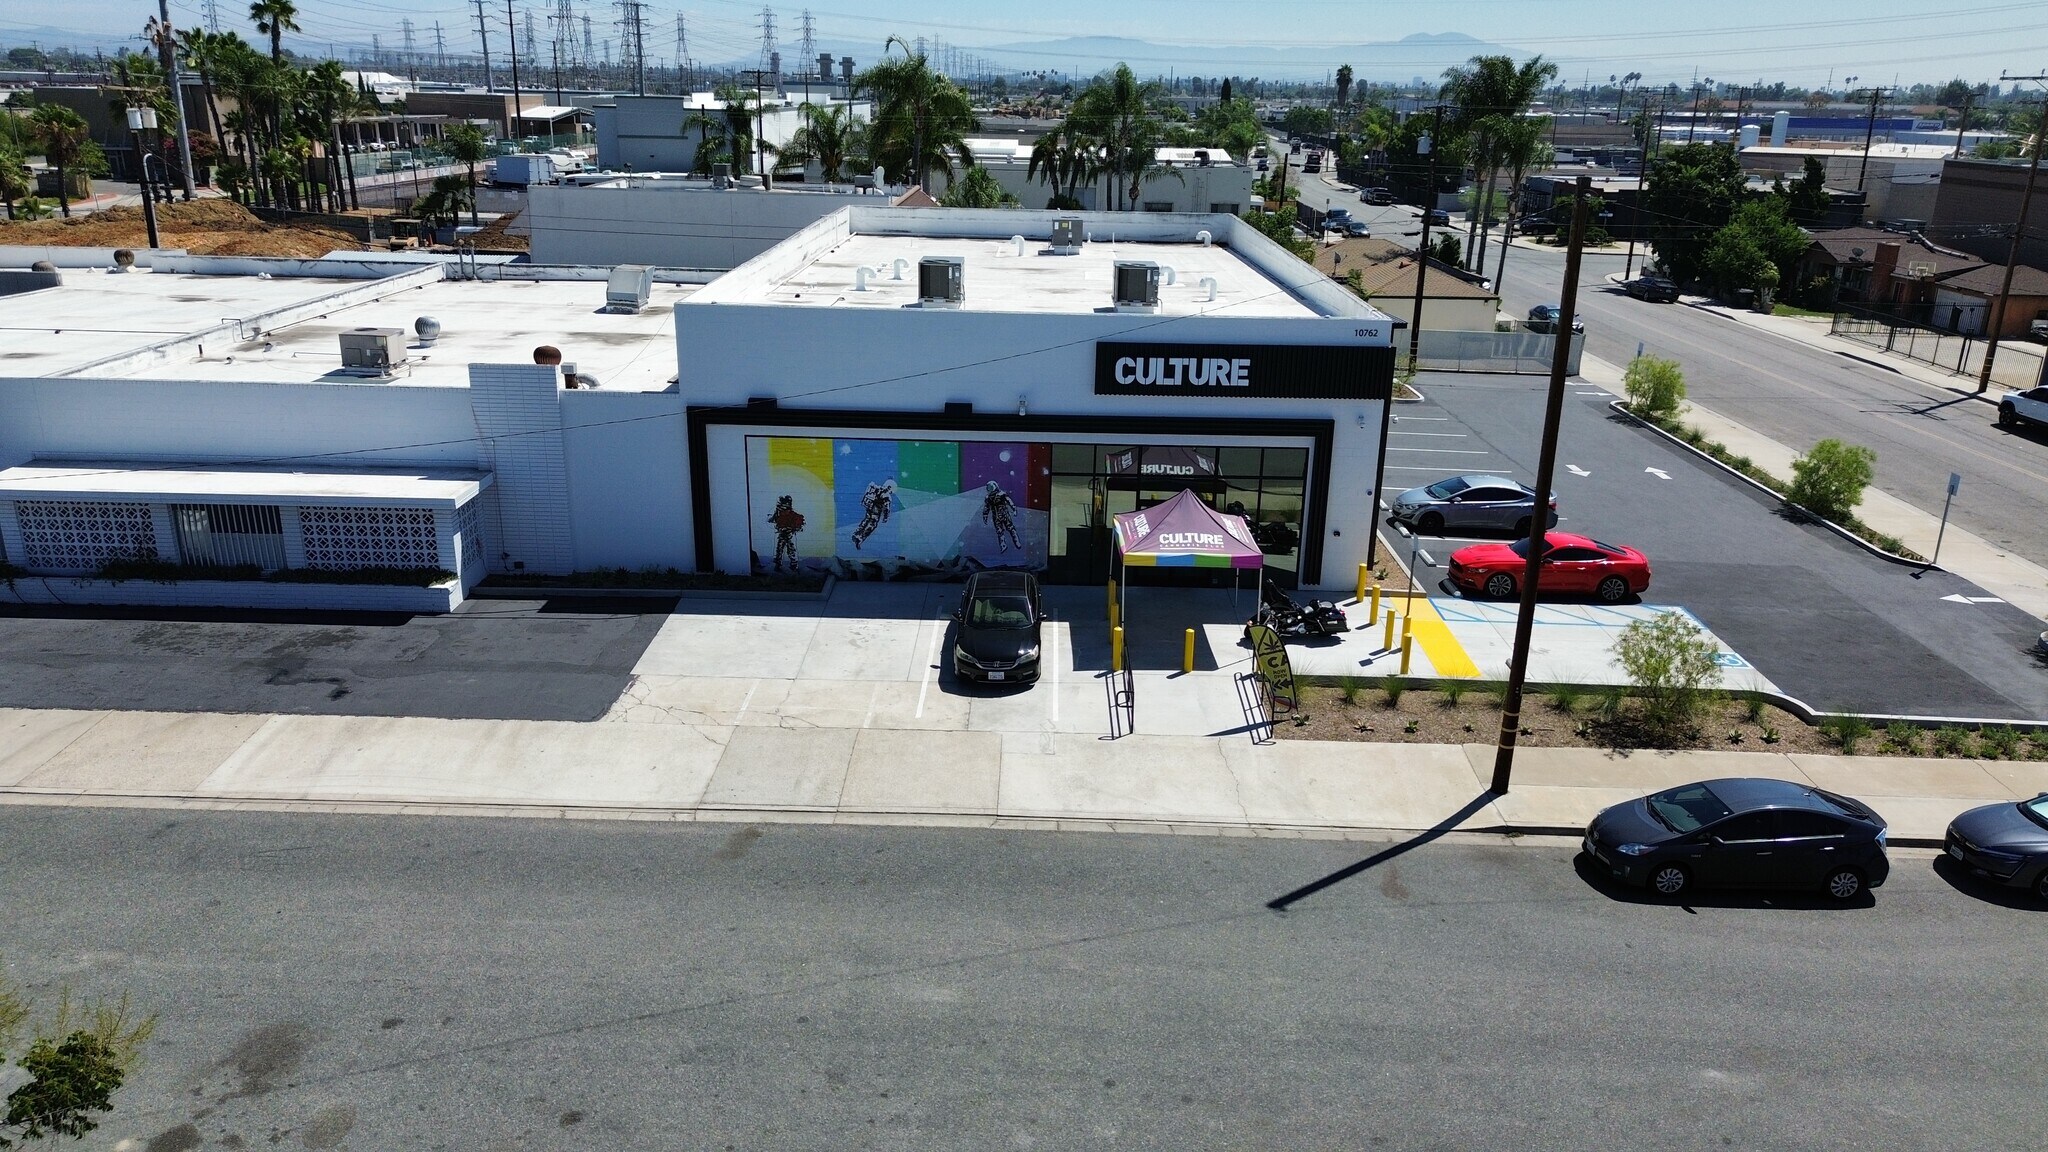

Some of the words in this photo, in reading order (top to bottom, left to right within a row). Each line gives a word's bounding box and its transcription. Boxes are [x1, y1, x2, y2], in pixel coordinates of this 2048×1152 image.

[1354, 329, 1379, 337] 10762
[1114, 356, 1251, 387] CULTURE
[1159, 532, 1224, 545] CULTURE
